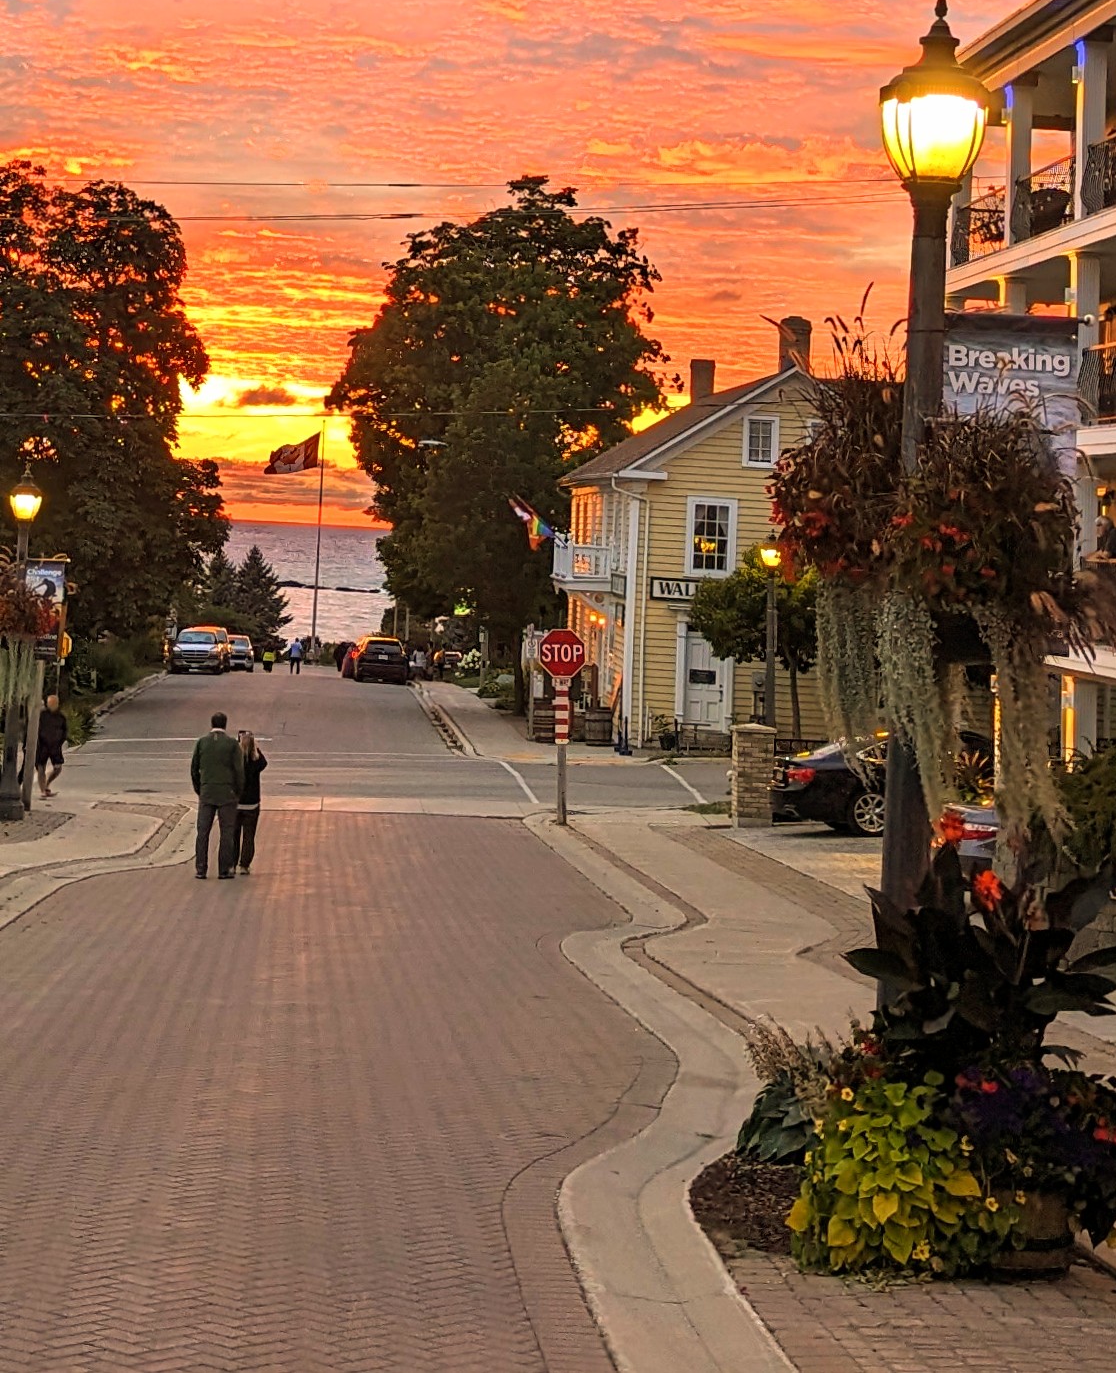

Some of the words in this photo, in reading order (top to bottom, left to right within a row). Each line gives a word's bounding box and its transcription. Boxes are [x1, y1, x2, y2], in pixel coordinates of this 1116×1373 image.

[948, 371, 1041, 398] Waves
[27, 568, 63, 577] Challenge
[541, 644, 584, 663] STOP
